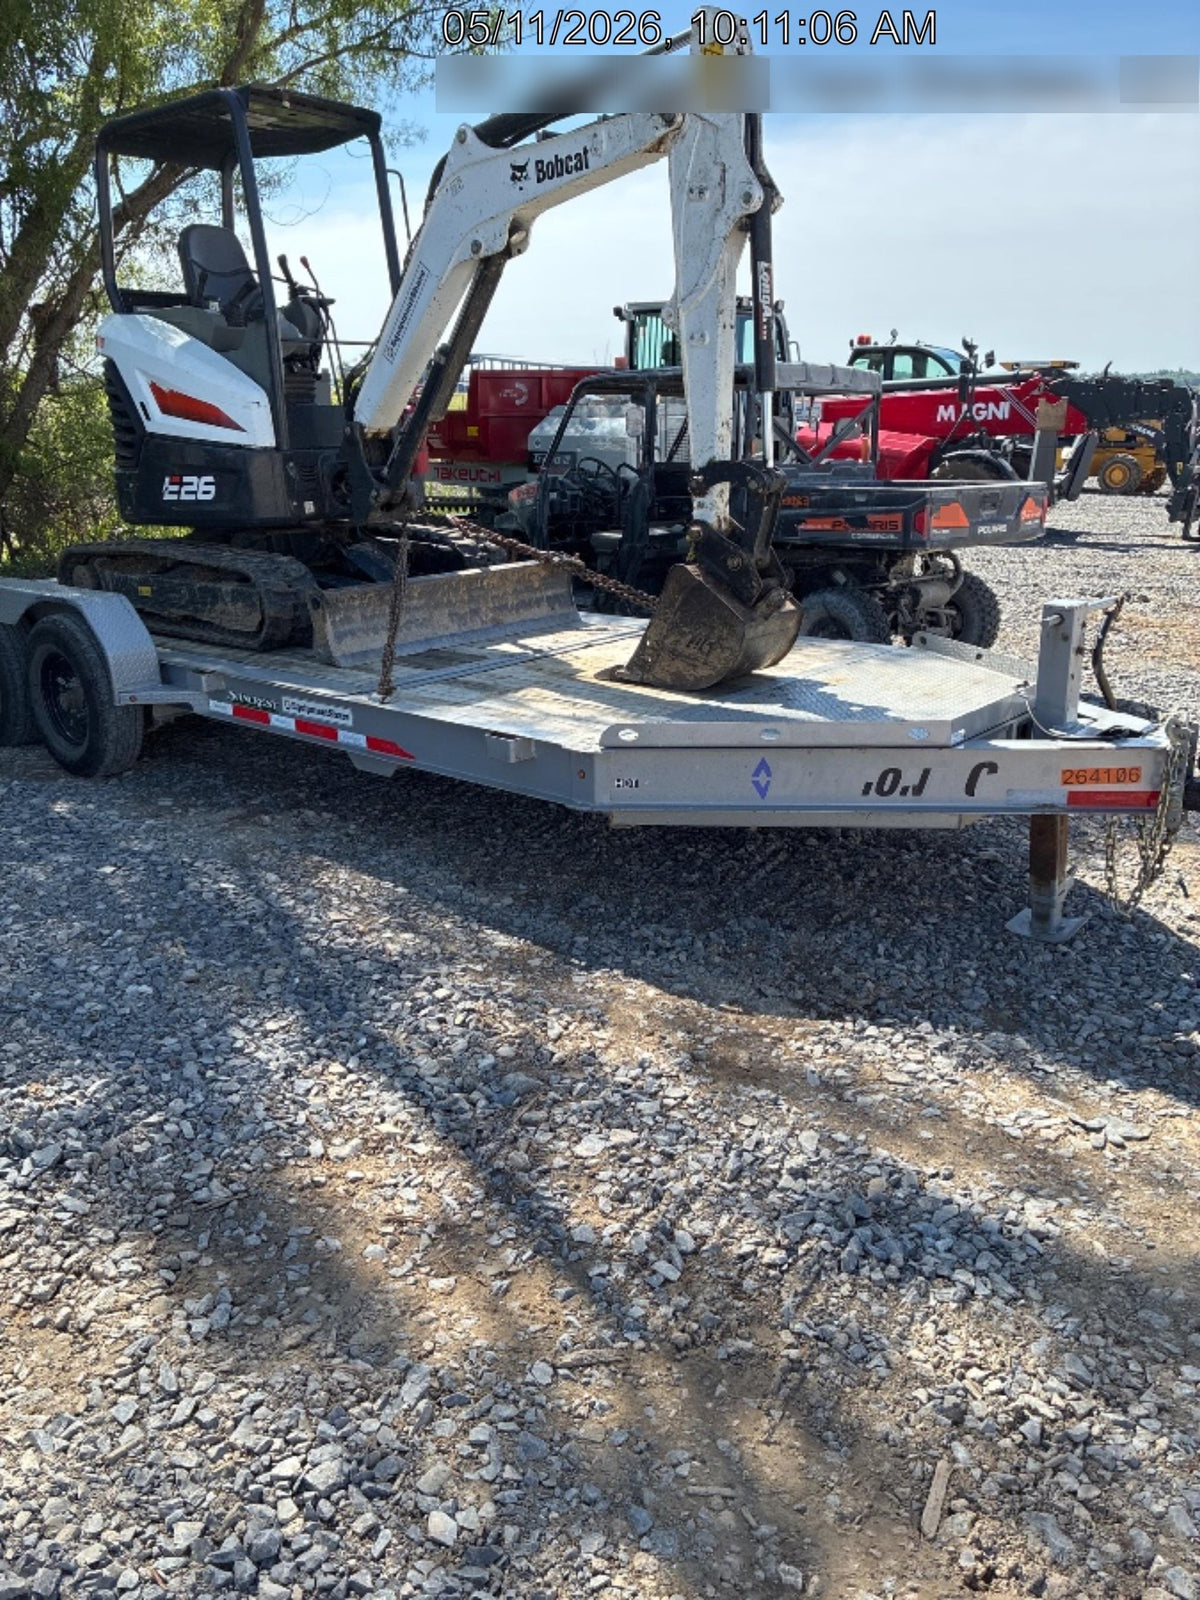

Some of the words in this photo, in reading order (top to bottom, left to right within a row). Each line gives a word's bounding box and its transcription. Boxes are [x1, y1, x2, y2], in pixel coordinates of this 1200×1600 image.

[535, 145, 589, 183] Bobcat
[162, 475, 216, 500] E26
[831, 520, 899, 531] PRIS
[1062, 767, 1141, 785] 264106
